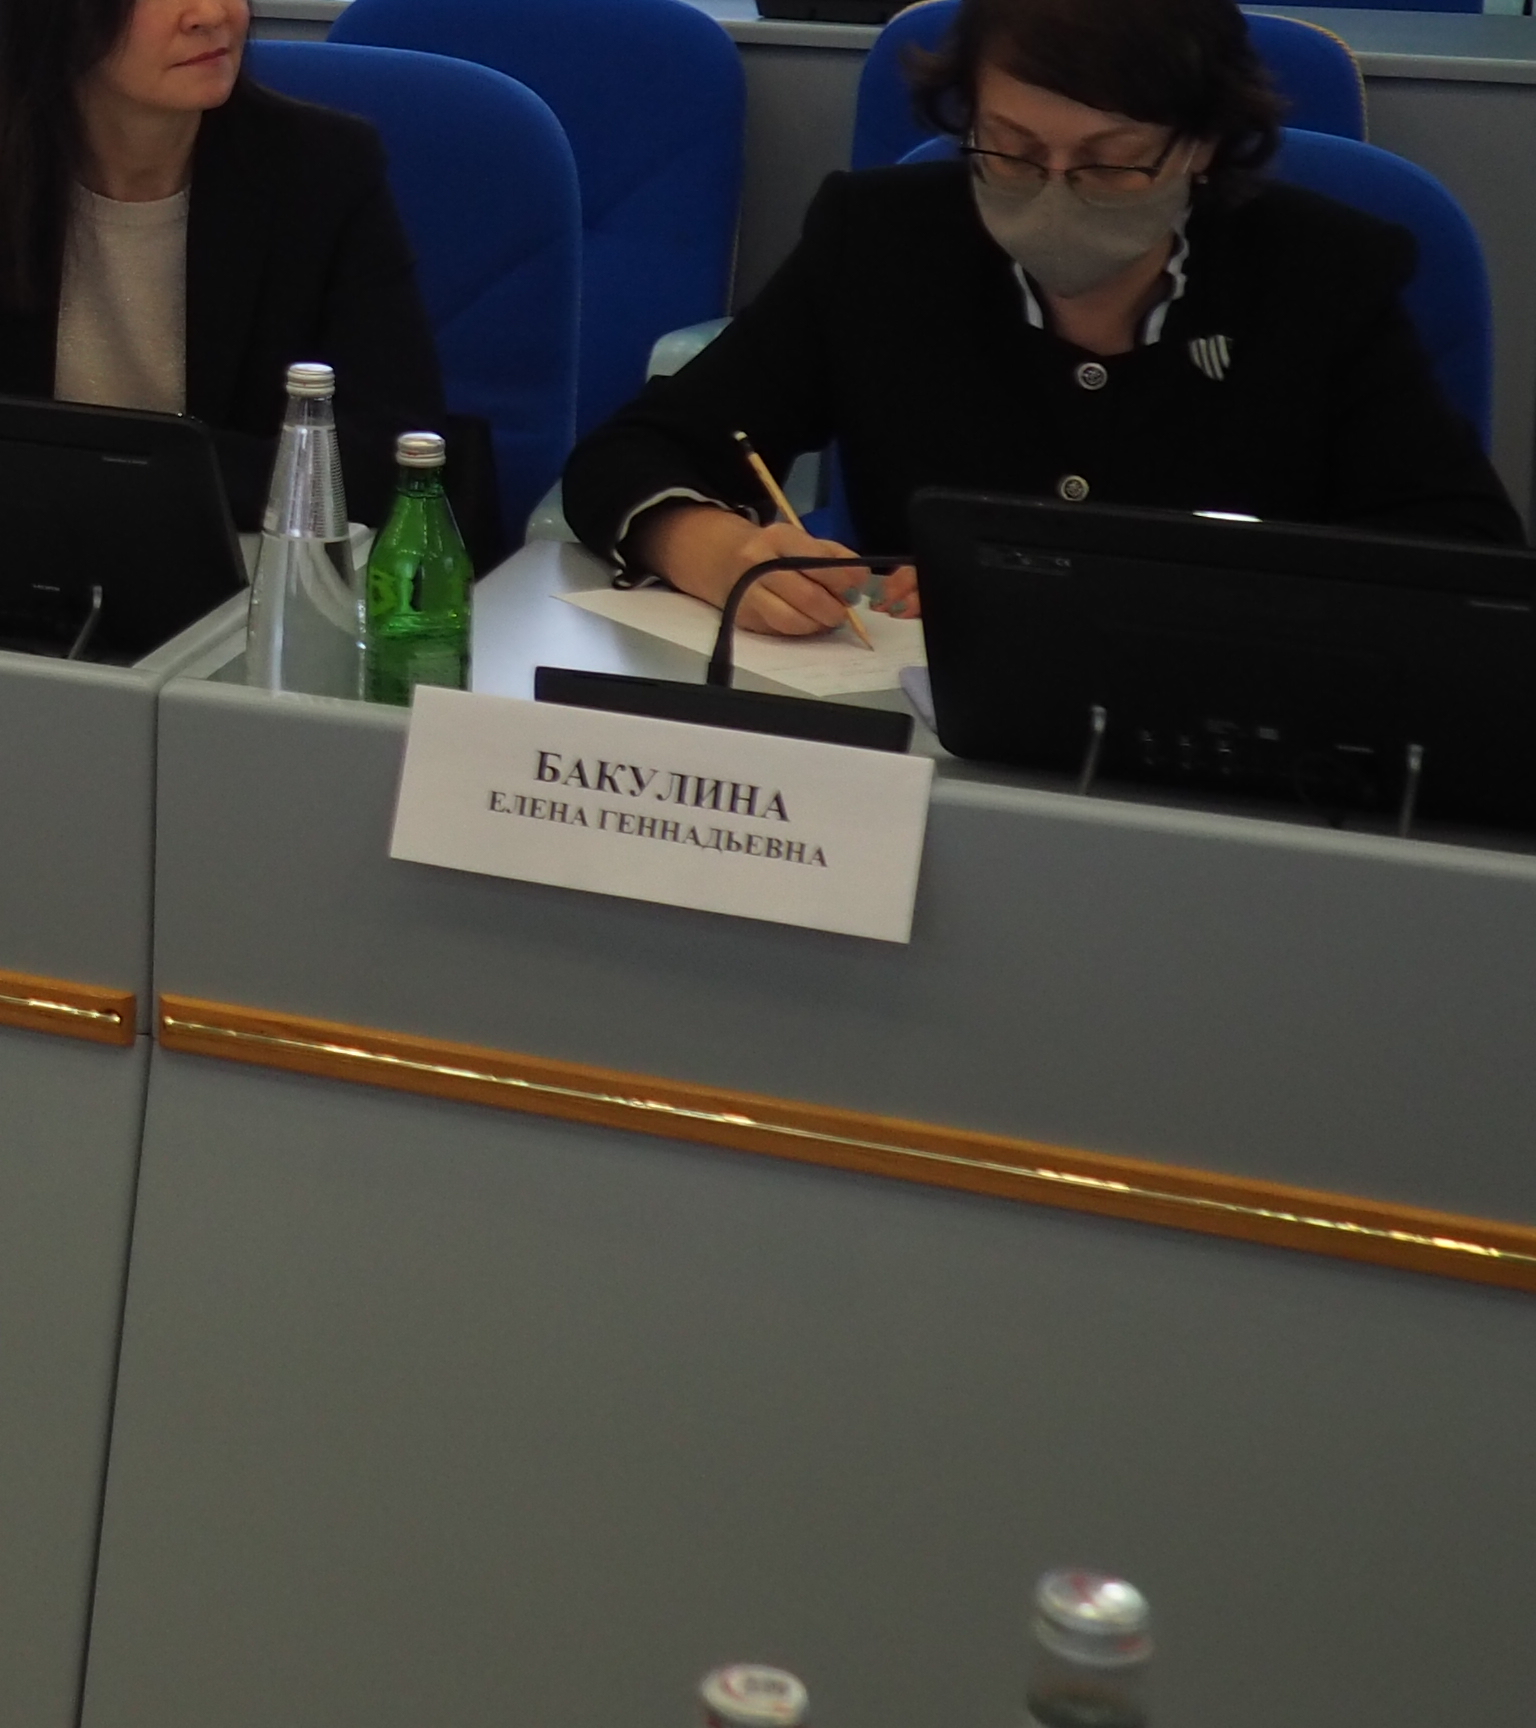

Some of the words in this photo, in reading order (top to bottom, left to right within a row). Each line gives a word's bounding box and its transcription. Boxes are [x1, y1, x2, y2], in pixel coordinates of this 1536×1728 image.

[533, 748, 790, 824] БАКУЛИНА
[488, 789, 589, 829] ЕЛЕНА
[598, 809, 829, 870] ГЕННАДЬЕВНА
